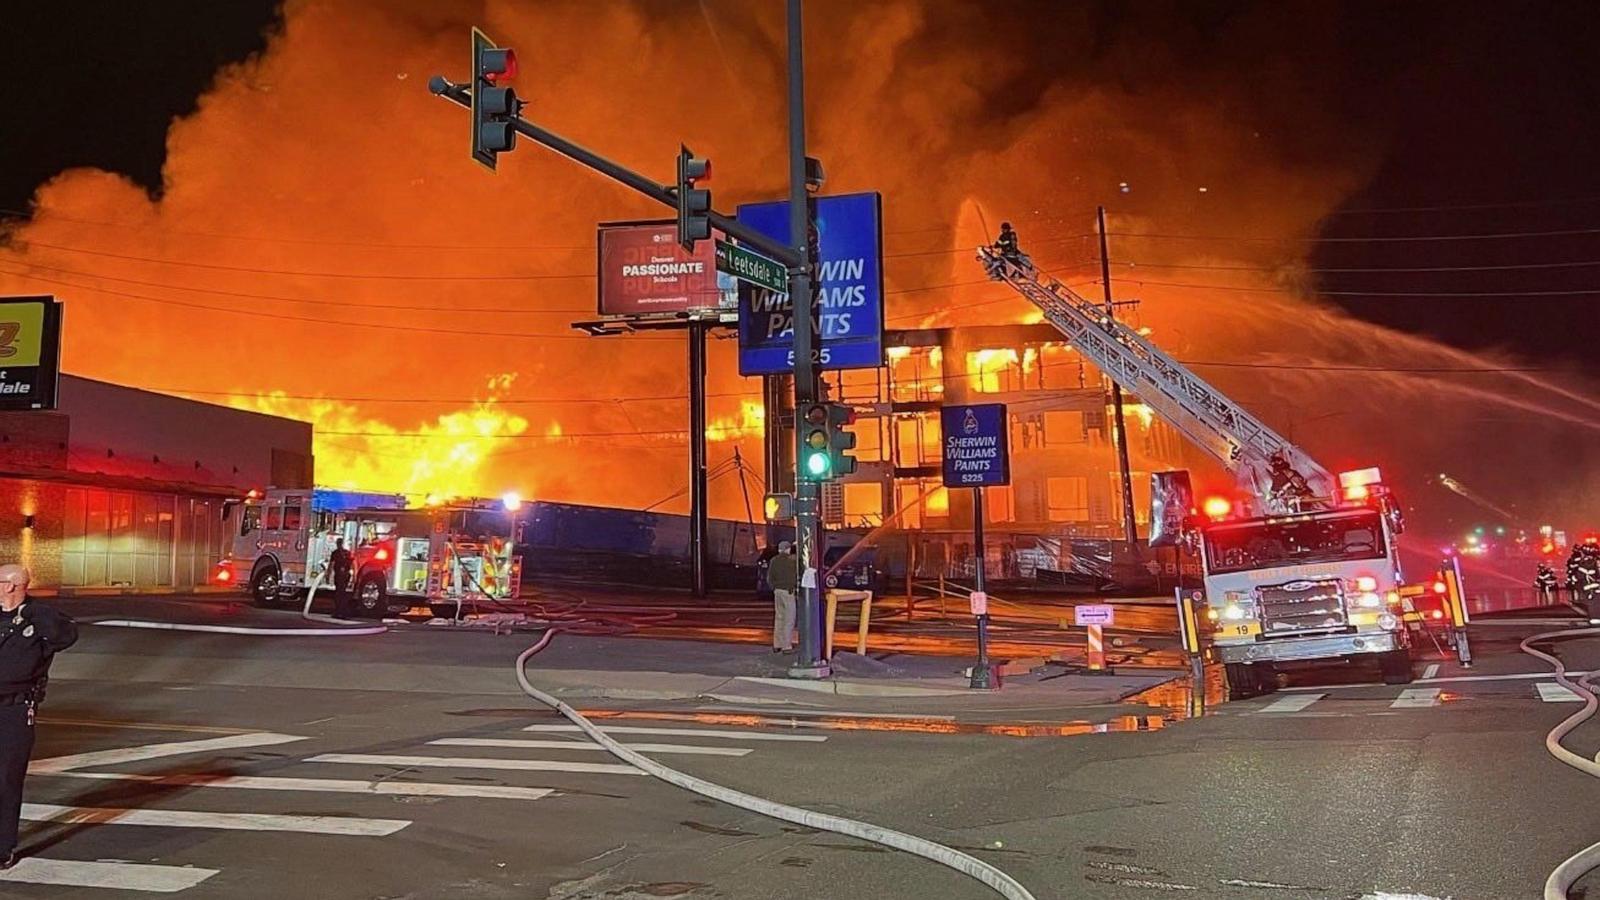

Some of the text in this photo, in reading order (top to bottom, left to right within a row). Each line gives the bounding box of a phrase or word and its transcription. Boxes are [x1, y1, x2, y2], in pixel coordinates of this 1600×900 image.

[622, 262, 704, 277] PASSIONATE
[728, 249, 771, 283] Leetsdale
[786, 348, 831, 366] 525
[947, 436, 996, 447] SHERWIN
[946, 447, 997, 459] WILLIAMS
[954, 460, 991, 471] PAINTS
[962, 473, 983, 482] 5225
[1236, 626, 1248, 635] 19
